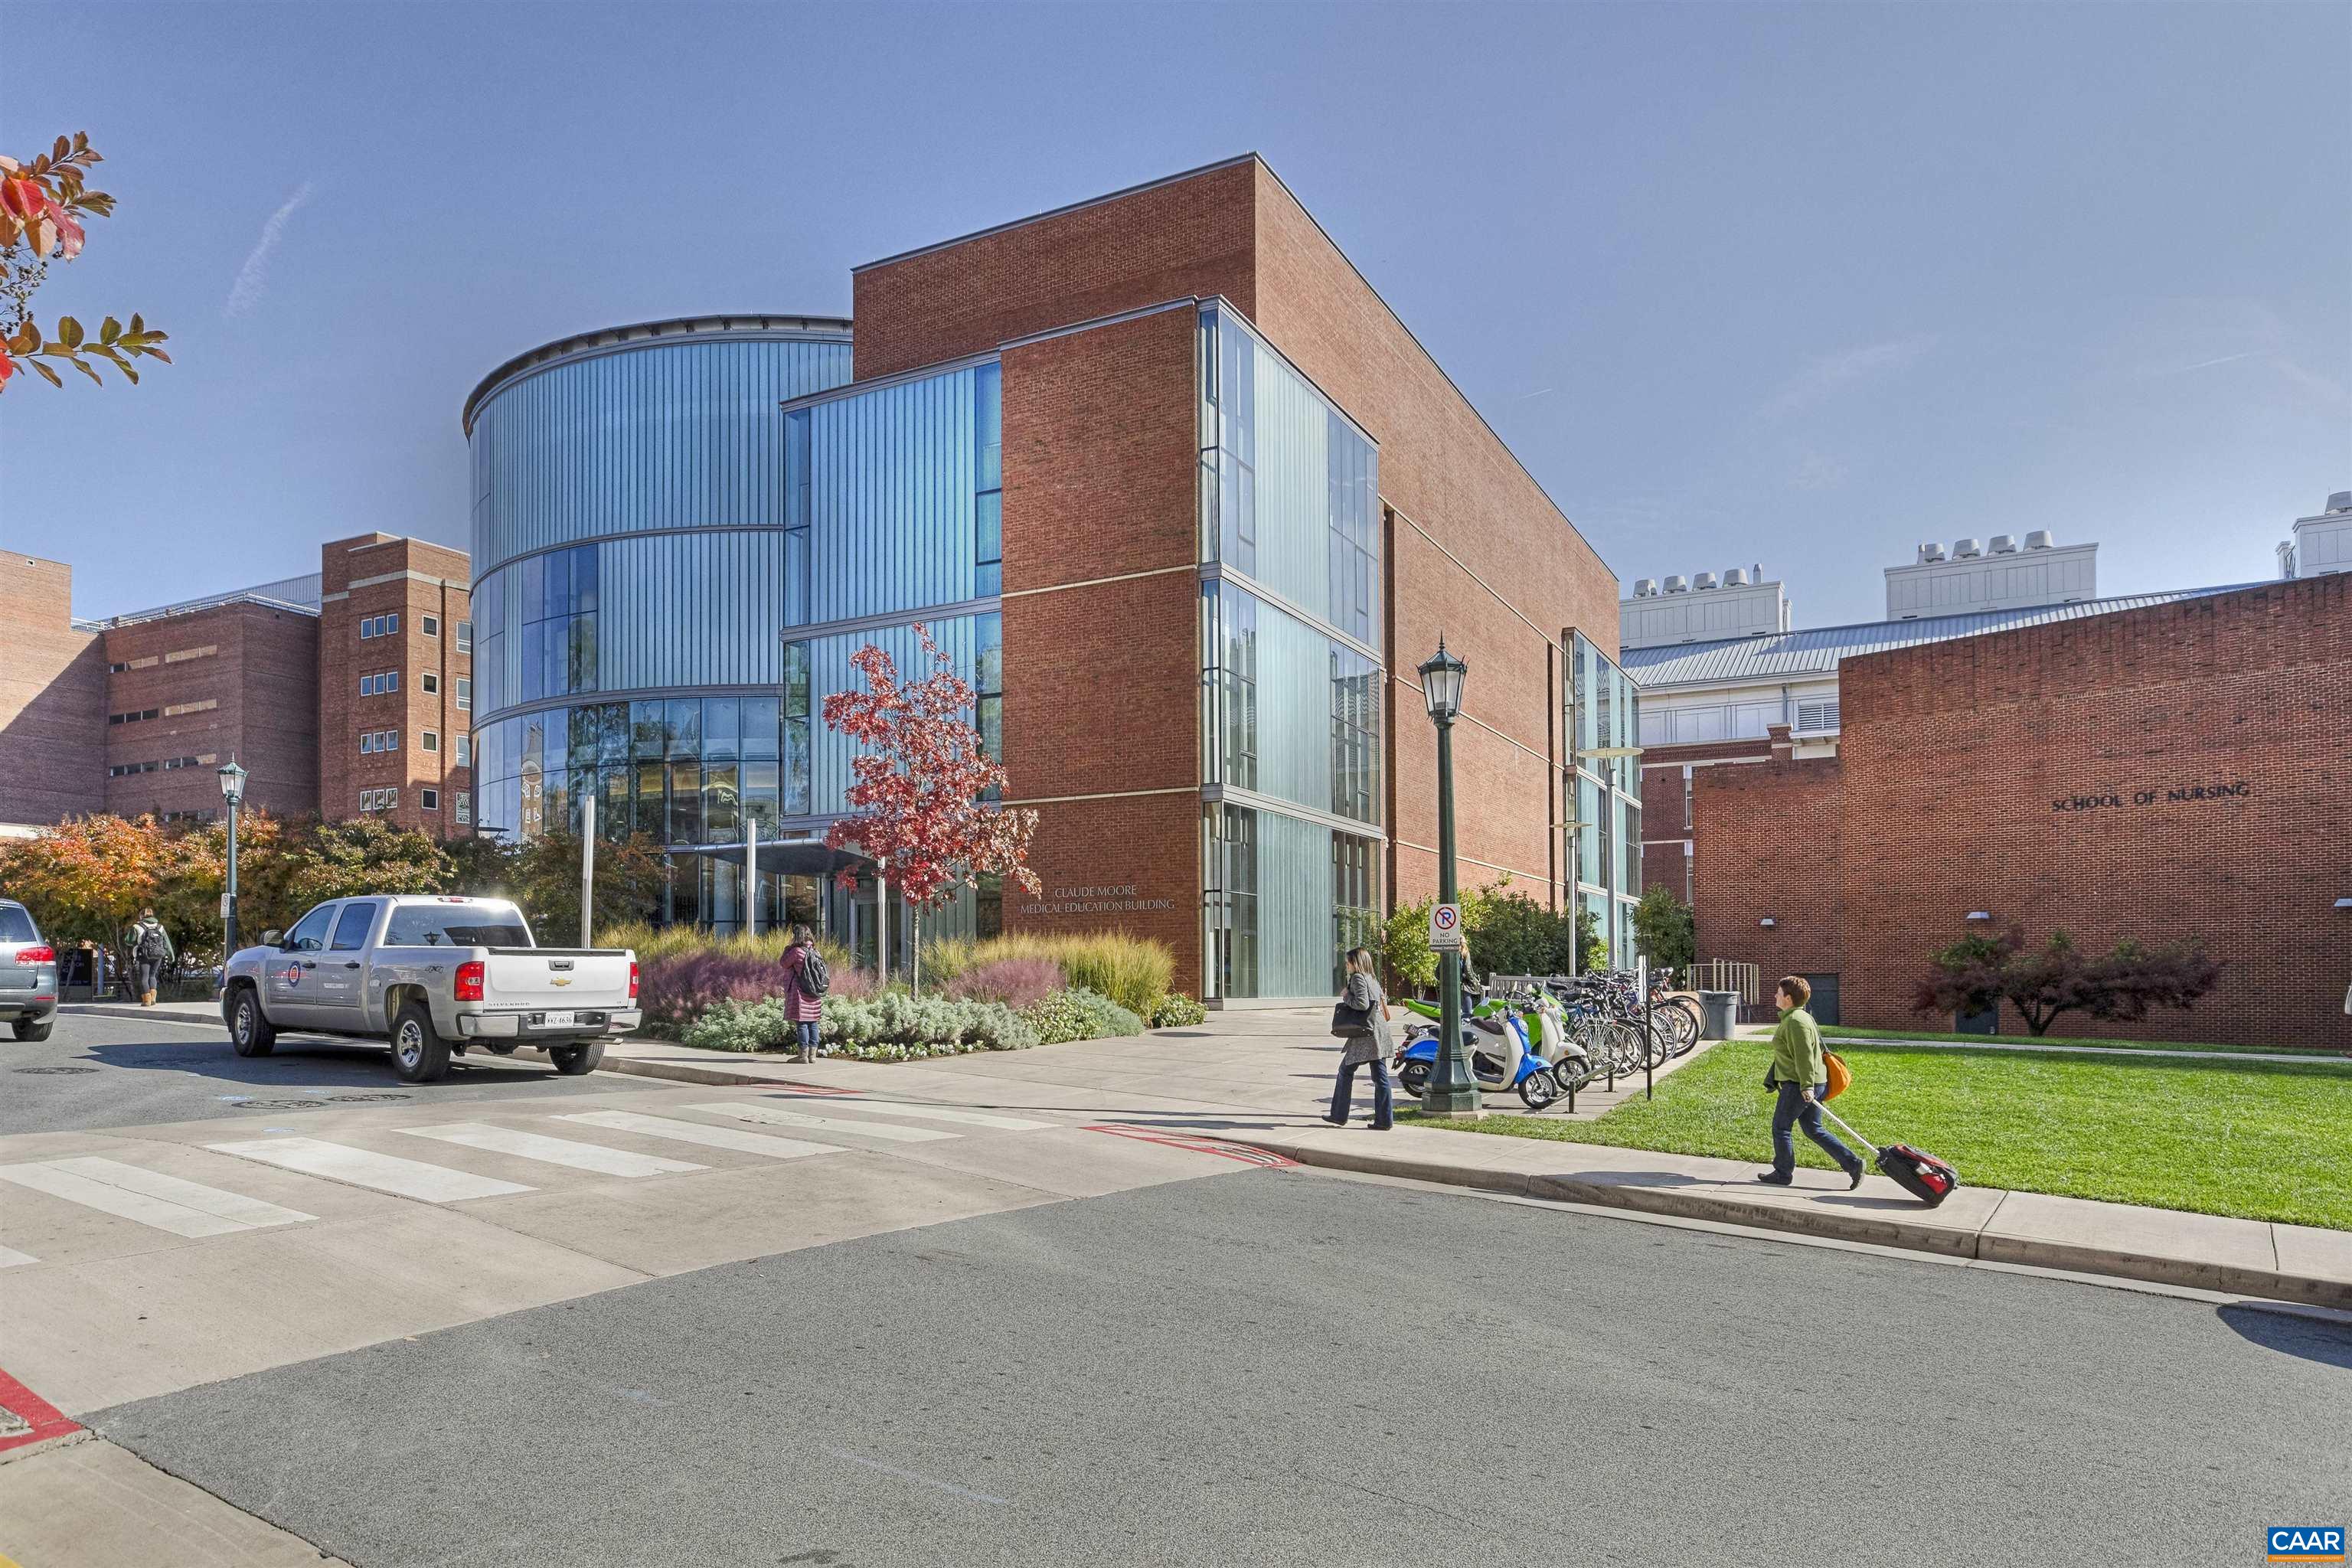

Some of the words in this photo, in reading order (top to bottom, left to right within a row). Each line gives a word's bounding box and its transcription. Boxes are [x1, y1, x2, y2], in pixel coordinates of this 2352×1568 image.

[2052, 795, 2122, 812] SCHOOL
[2134, 792, 2156, 805] OF
[2167, 781, 2249, 802] NURSING
[1054, 887, 1095, 899] CLAUDE
[1097, 884, 1137, 897] MOORE
[1021, 903, 1063, 914] MEDICAL
[1064, 900, 1122, 913] EDUCATION
[1125, 898, 1175, 910] BUILDING
